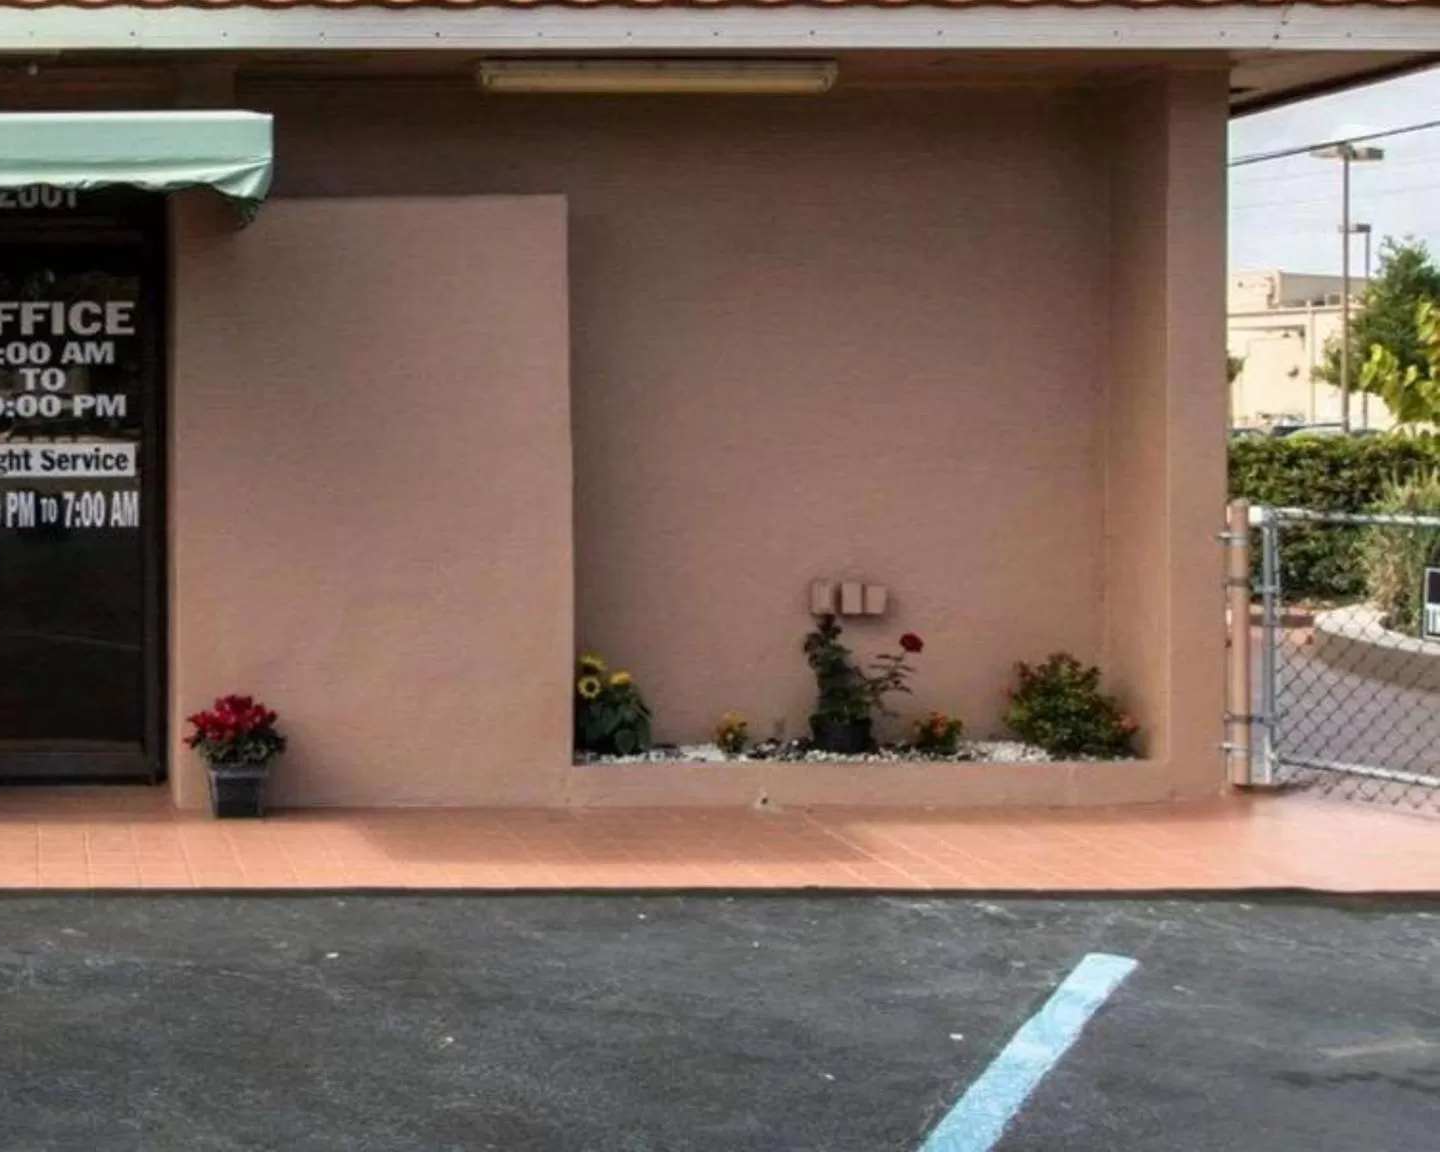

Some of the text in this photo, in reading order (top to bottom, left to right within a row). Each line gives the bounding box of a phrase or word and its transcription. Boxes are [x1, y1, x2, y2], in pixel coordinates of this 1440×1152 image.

[60, 341, 116, 365] AM
[19, 367, 67, 391] TO
[72, 394, 128, 418] PM
[40, 447, 129, 472] Service
[6, 491, 35, 528] PM
[62, 491, 105, 528] 7:00
[110, 491, 140, 528] AM
